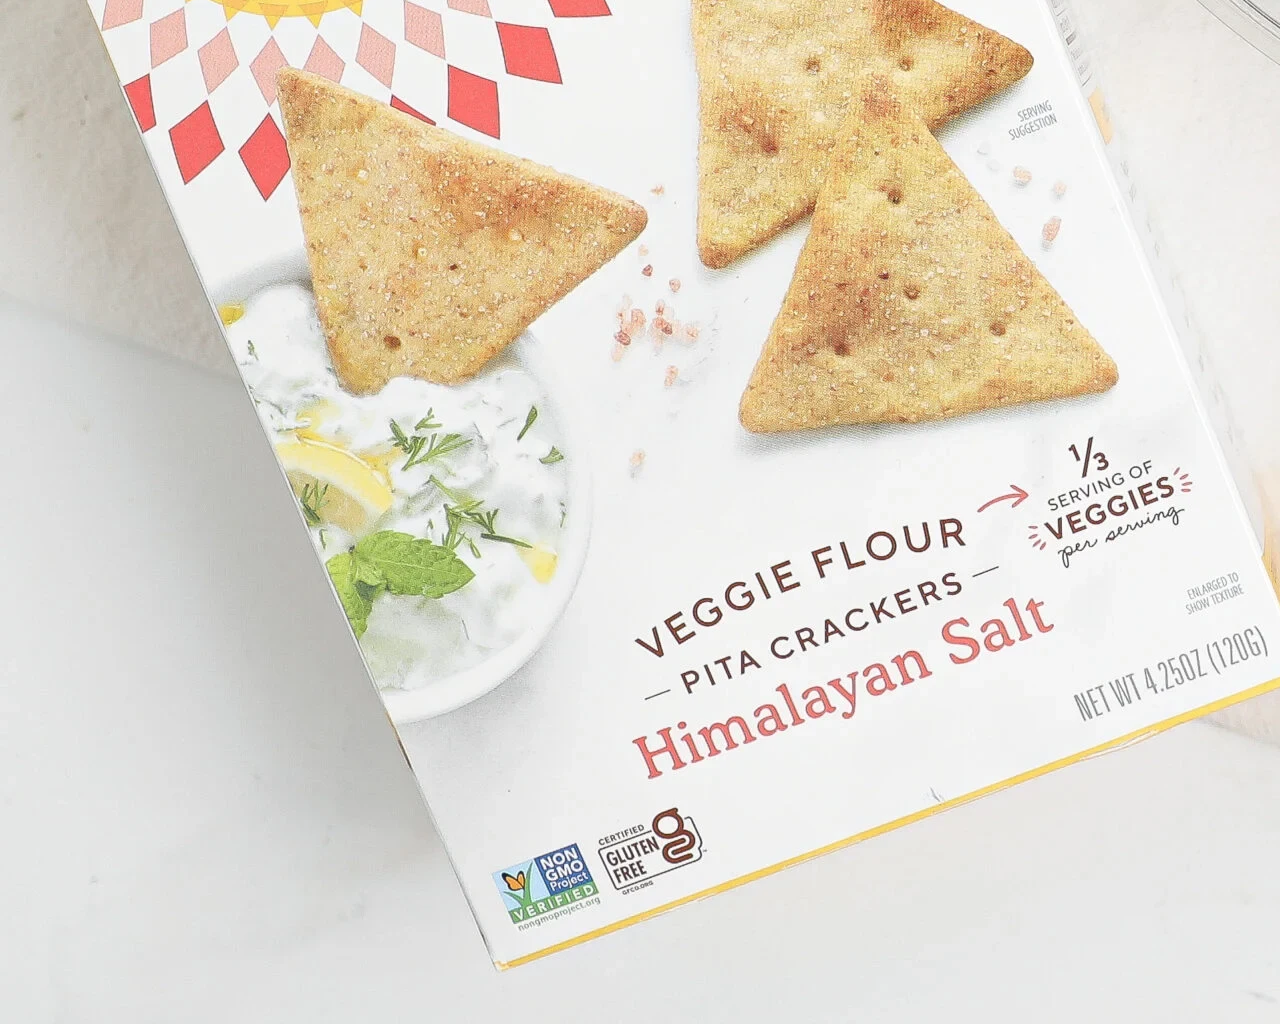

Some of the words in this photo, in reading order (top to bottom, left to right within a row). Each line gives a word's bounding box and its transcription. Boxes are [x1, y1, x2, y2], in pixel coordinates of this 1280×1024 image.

[1017, 99, 1052, 122] SERVING
[1008, 113, 1058, 141] SUGGESTION
[1047, 472, 1125, 511] SERVING
[1129, 460, 1153, 479] OF
[1043, 476, 1175, 540] VEGGIES
[1057, 538, 1098, 569] per
[1105, 506, 1185, 543] serving
[634, 559, 801, 659] VEGGIE
[810, 517, 966, 579] FLOUR
[1185, 597, 1211, 615] SHOW
[1210, 583, 1244, 606] TEXTURE
[1186, 575, 1228, 600] ENLARGED
[1226, 572, 1240, 583] TO
[680, 649, 762, 695] PITA
[770, 572, 963, 660] CRACKERS
[632, 649, 933, 780] Himalayan
[941, 597, 1055, 665] Salt
[1073, 685, 1111, 722] NET
[1108, 673, 1142, 708] WT
[1206, 625, 1269, 675] (120G)
[598, 824, 645, 846] CERTIFIED
[540, 847, 578, 870] NON
[606, 836, 660, 867] GLUTEN
[545, 859, 584, 882] GMO
[550, 871, 589, 892] Project
[613, 860, 647, 884] FREE
[514, 885, 594, 921] VERIFIED
[518, 897, 601, 932] nongmoproject.org
